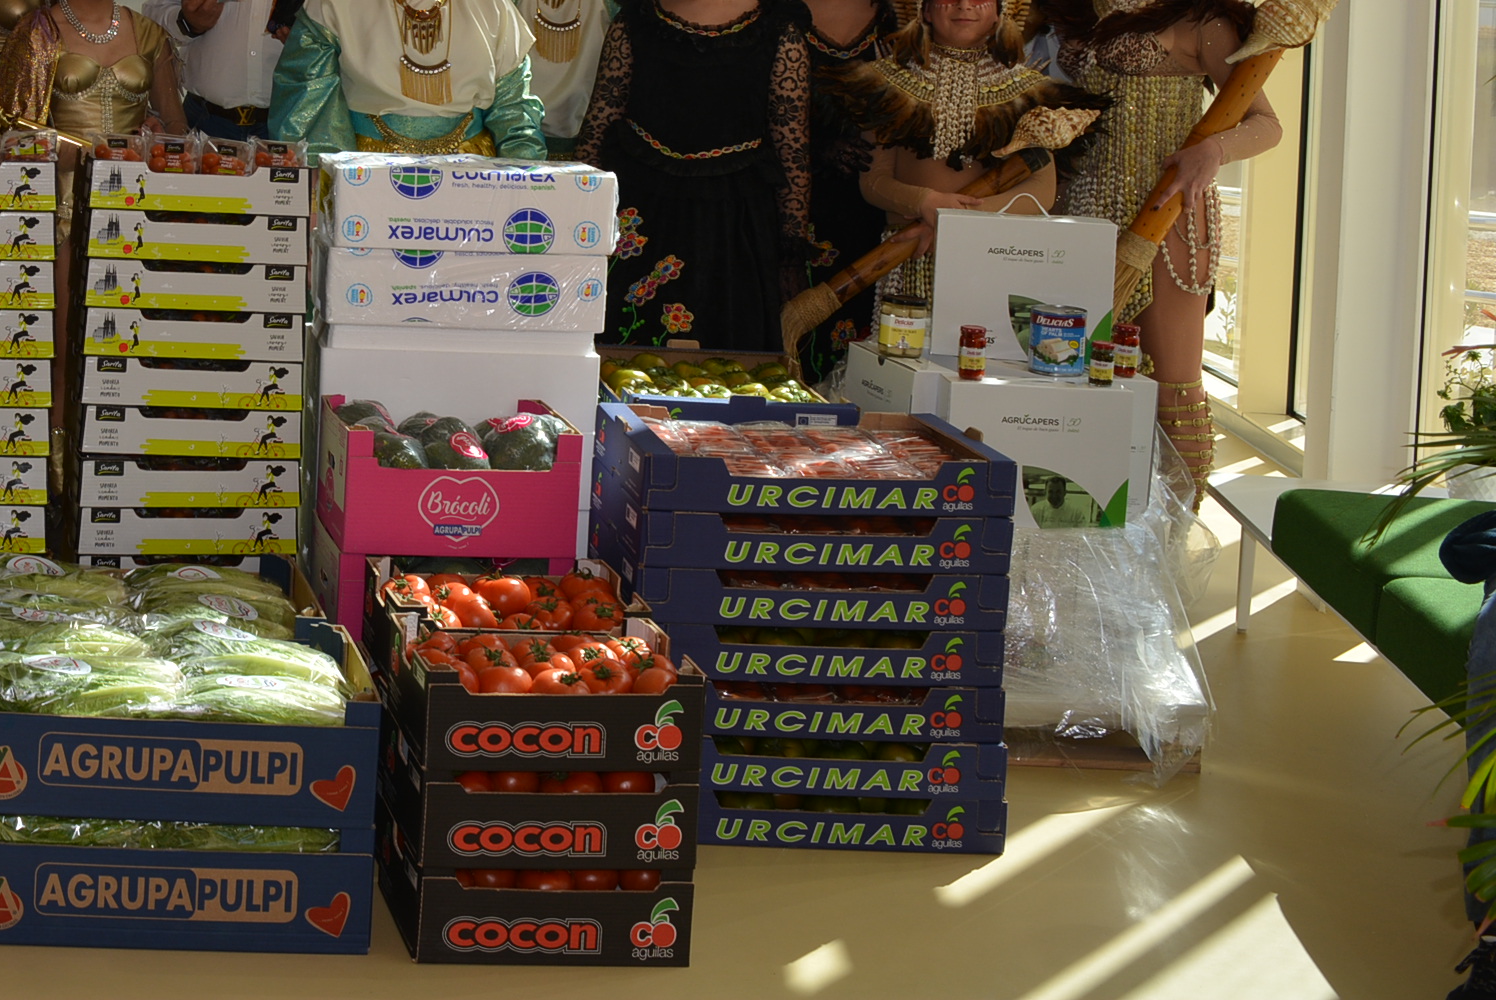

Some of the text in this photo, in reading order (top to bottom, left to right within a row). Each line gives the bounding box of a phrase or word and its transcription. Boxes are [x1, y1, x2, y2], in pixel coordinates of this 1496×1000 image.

[388, 225, 494, 243] culmarex
[987, 246, 1044, 257] AGRUCAPERS
[391, 290, 499, 305] culmarex
[1036, 315, 1075, 327] DELICIAS
[1001, 415, 1059, 426] AGRUCAPERS
[427, 491, 491, 516] Brócoli
[727, 483, 938, 510] URCIMAR
[434, 525, 481, 536] AGRUPAPULPI
[724, 540, 935, 567] URCIMAR
[718, 596, 930, 623] URCIMAR
[715, 651, 926, 679] URCIMAR
[713, 707, 926, 735] URCIMAR
[447, 722, 605, 757] cocon
[42, 742, 298, 786] AGRUPAPULPI
[710, 763, 923, 791] URCIMAR
[450, 822, 605, 856] cocon
[716, 818, 927, 846] URCIMAR
[38, 873, 293, 914] AGRUPAPULPI
[445, 918, 600, 953] cocon
